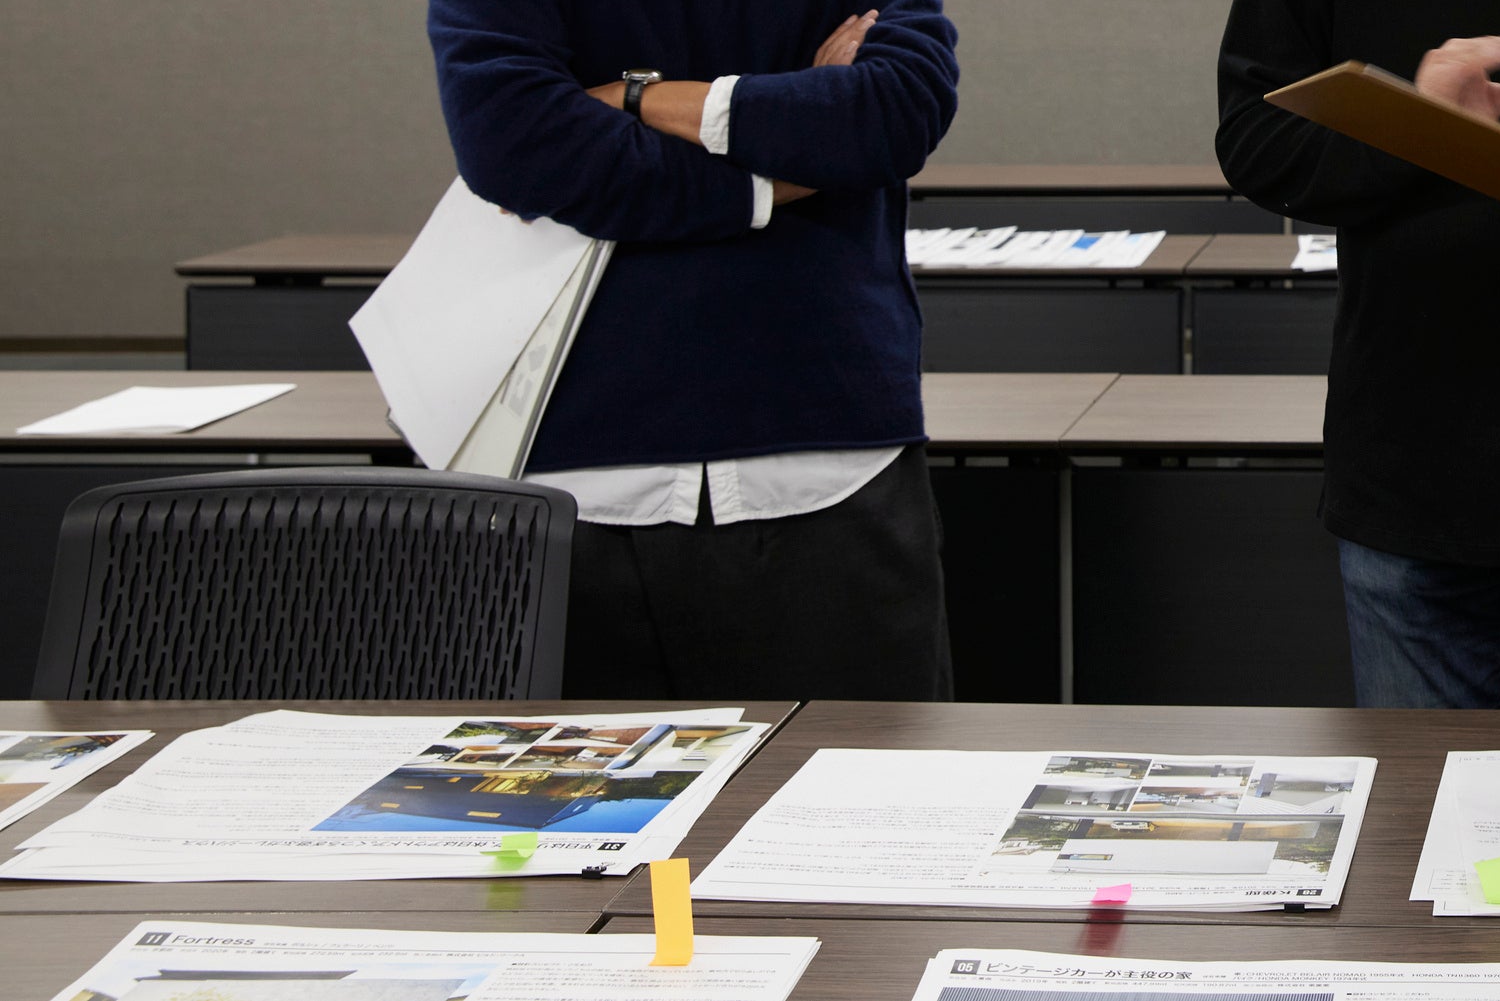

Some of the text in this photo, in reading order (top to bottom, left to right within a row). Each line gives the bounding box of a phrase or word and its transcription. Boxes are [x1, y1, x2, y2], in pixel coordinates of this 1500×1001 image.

[171, 934, 256, 946] Fortress
[986, 962, 1193, 980] ビンテージカーが主役の家
